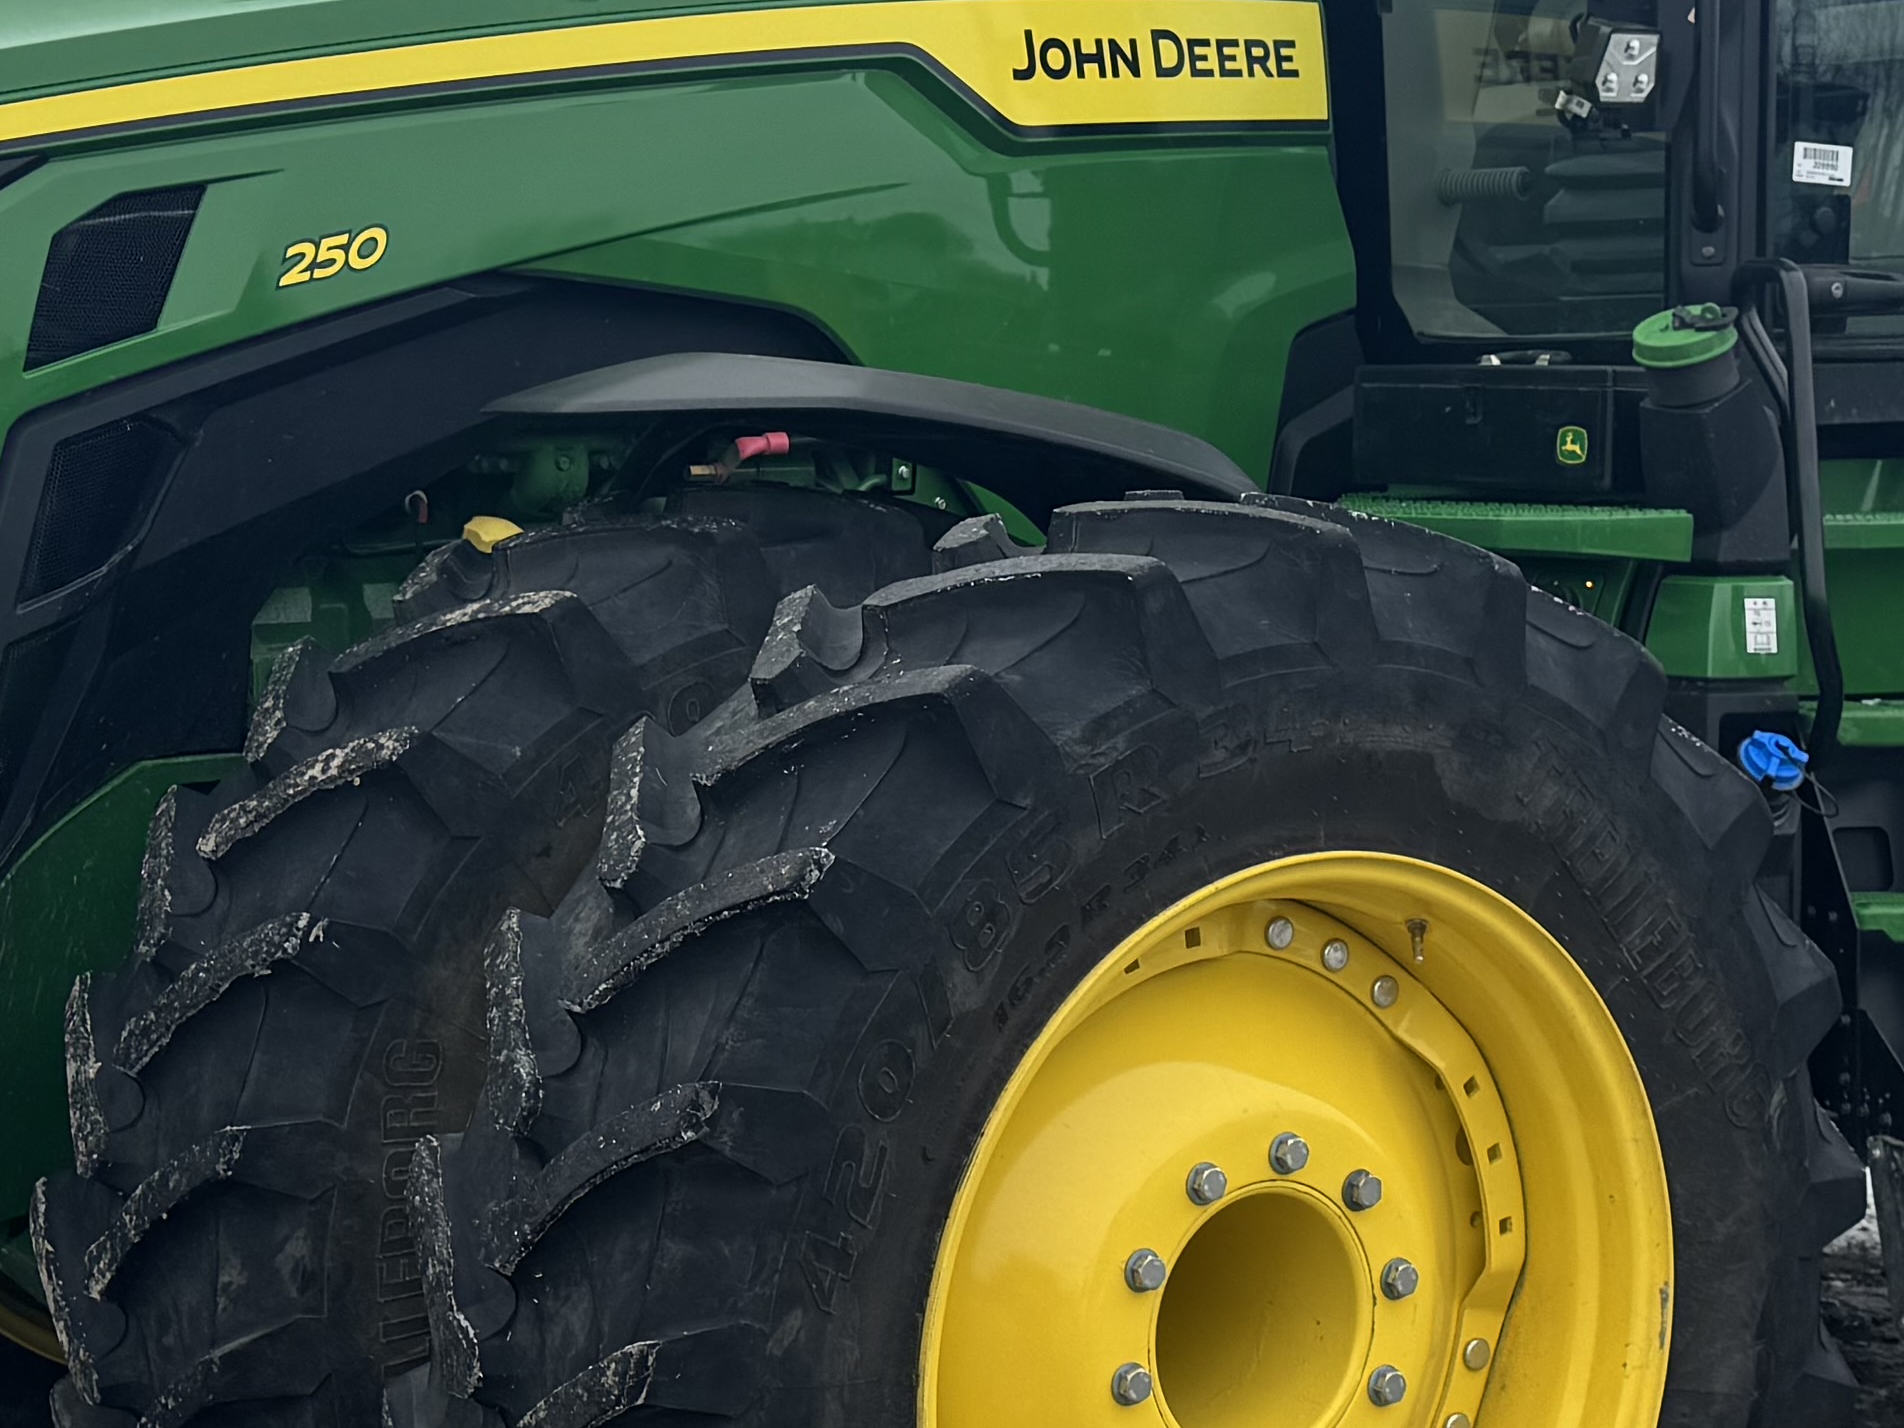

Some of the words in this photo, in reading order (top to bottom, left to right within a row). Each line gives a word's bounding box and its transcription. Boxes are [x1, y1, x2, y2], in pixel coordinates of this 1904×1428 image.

[1012, 29, 1141, 80] JOHN
[1150, 29, 1300, 78] DEERE
[278, 226, 388, 287] 250
